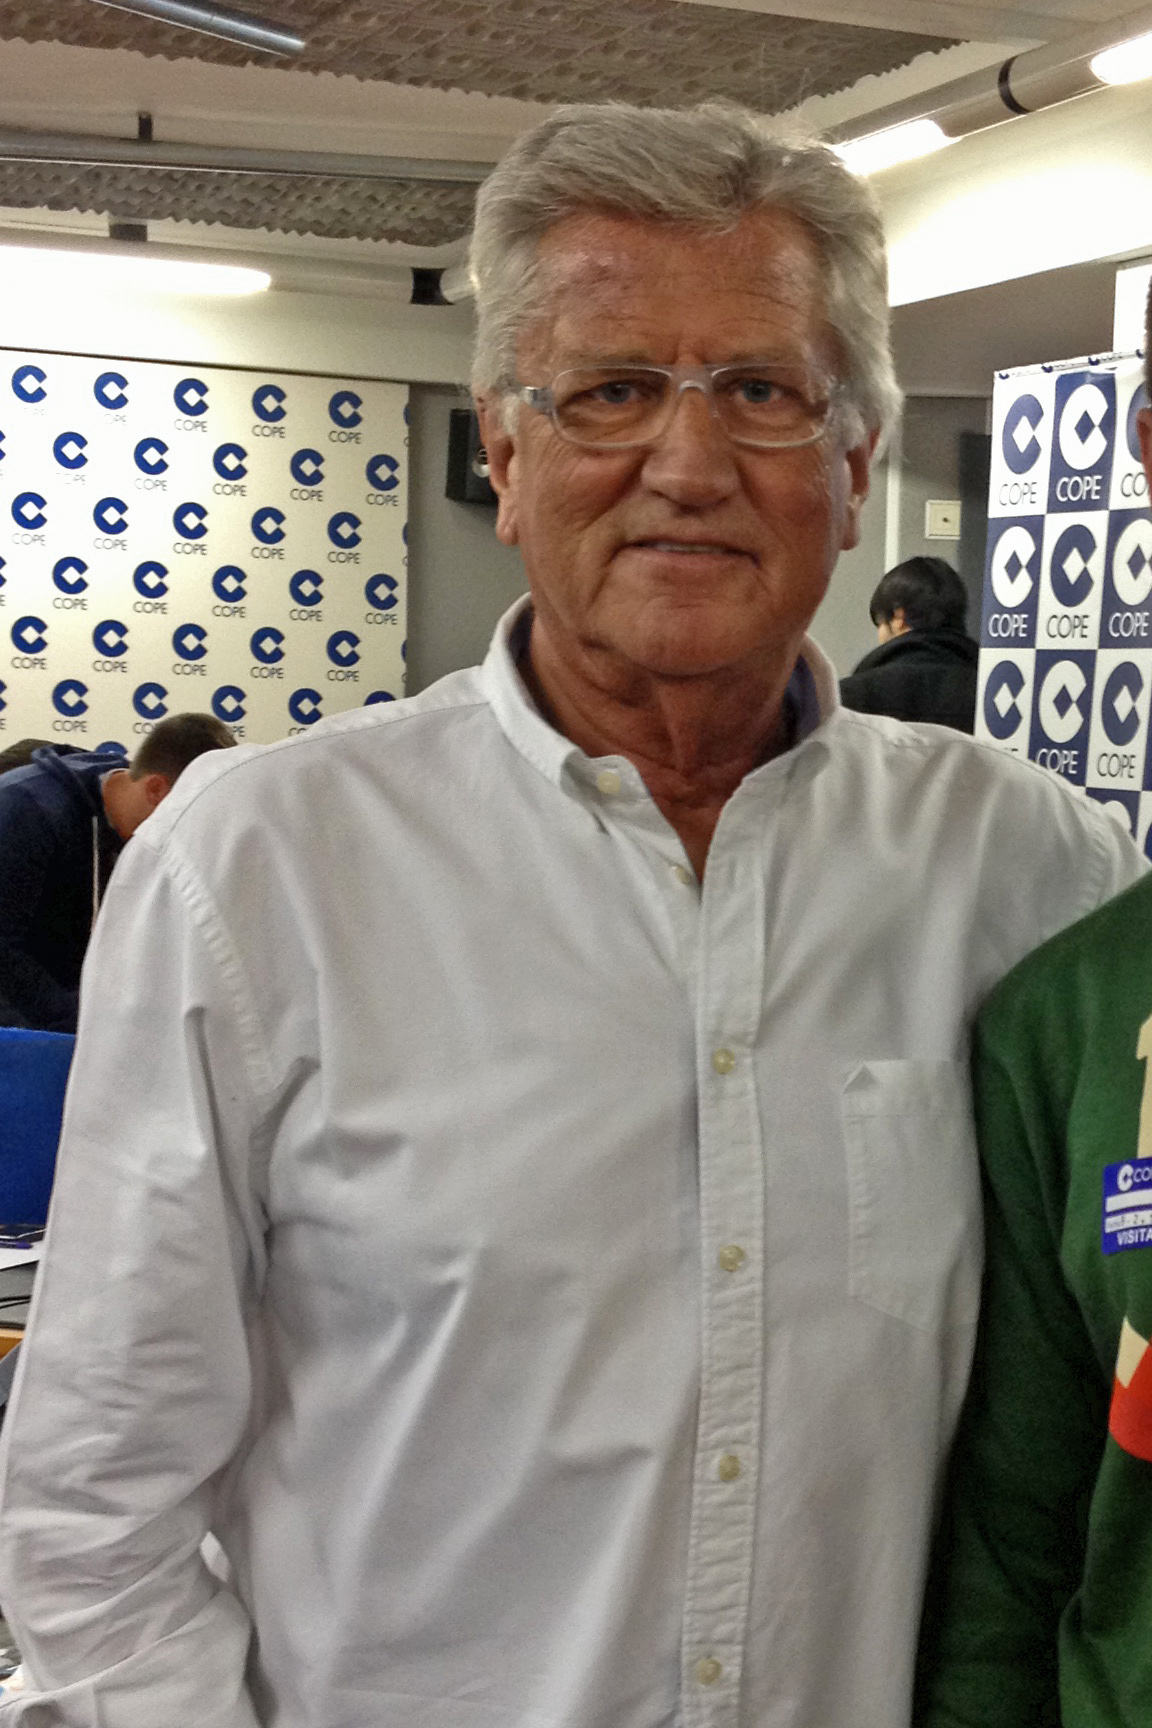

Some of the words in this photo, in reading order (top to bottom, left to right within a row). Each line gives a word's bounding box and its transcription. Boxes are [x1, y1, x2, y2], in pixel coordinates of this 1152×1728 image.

[174, 419, 208, 433] COPE
[252, 425, 286, 439] COPE
[328, 430, 362, 444] COPE
[134, 478, 168, 491] COPE
[213, 483, 247, 497] COPE
[1056, 475, 1102, 502] COPE
[1121, 472, 1148, 498] CO
[290, 488, 323, 502] COPE
[366, 493, 399, 507] COPE
[999, 482, 1038, 506] COPE
[12, 533, 46, 546] COPE
[93, 538, 128, 551] COPE
[173, 543, 207, 556] COPE
[251, 547, 285, 560] COPE
[327, 551, 361, 564] COPE
[53, 597, 88, 611] COPE
[133, 601, 168, 615] COPE
[212, 605, 246, 618] COPE
[289, 609, 323, 622] COPE
[365, 613, 398, 625] COPE
[988, 613, 1029, 638] COPE
[1108, 612, 1150, 638] COPE
[1046, 614, 1090, 639] COPE
[11, 657, 47, 670] COPE
[93, 660, 128, 673] COPE
[172, 663, 207, 676] COPE
[250, 666, 284, 679] COPE
[327, 669, 360, 682] COPE
[52, 720, 87, 733] COPE
[133, 722, 154, 734] CO
[1036, 748, 1079, 774] COPE
[1097, 753, 1136, 779] COPE
[1133, 1167, 1152, 1183] CO
